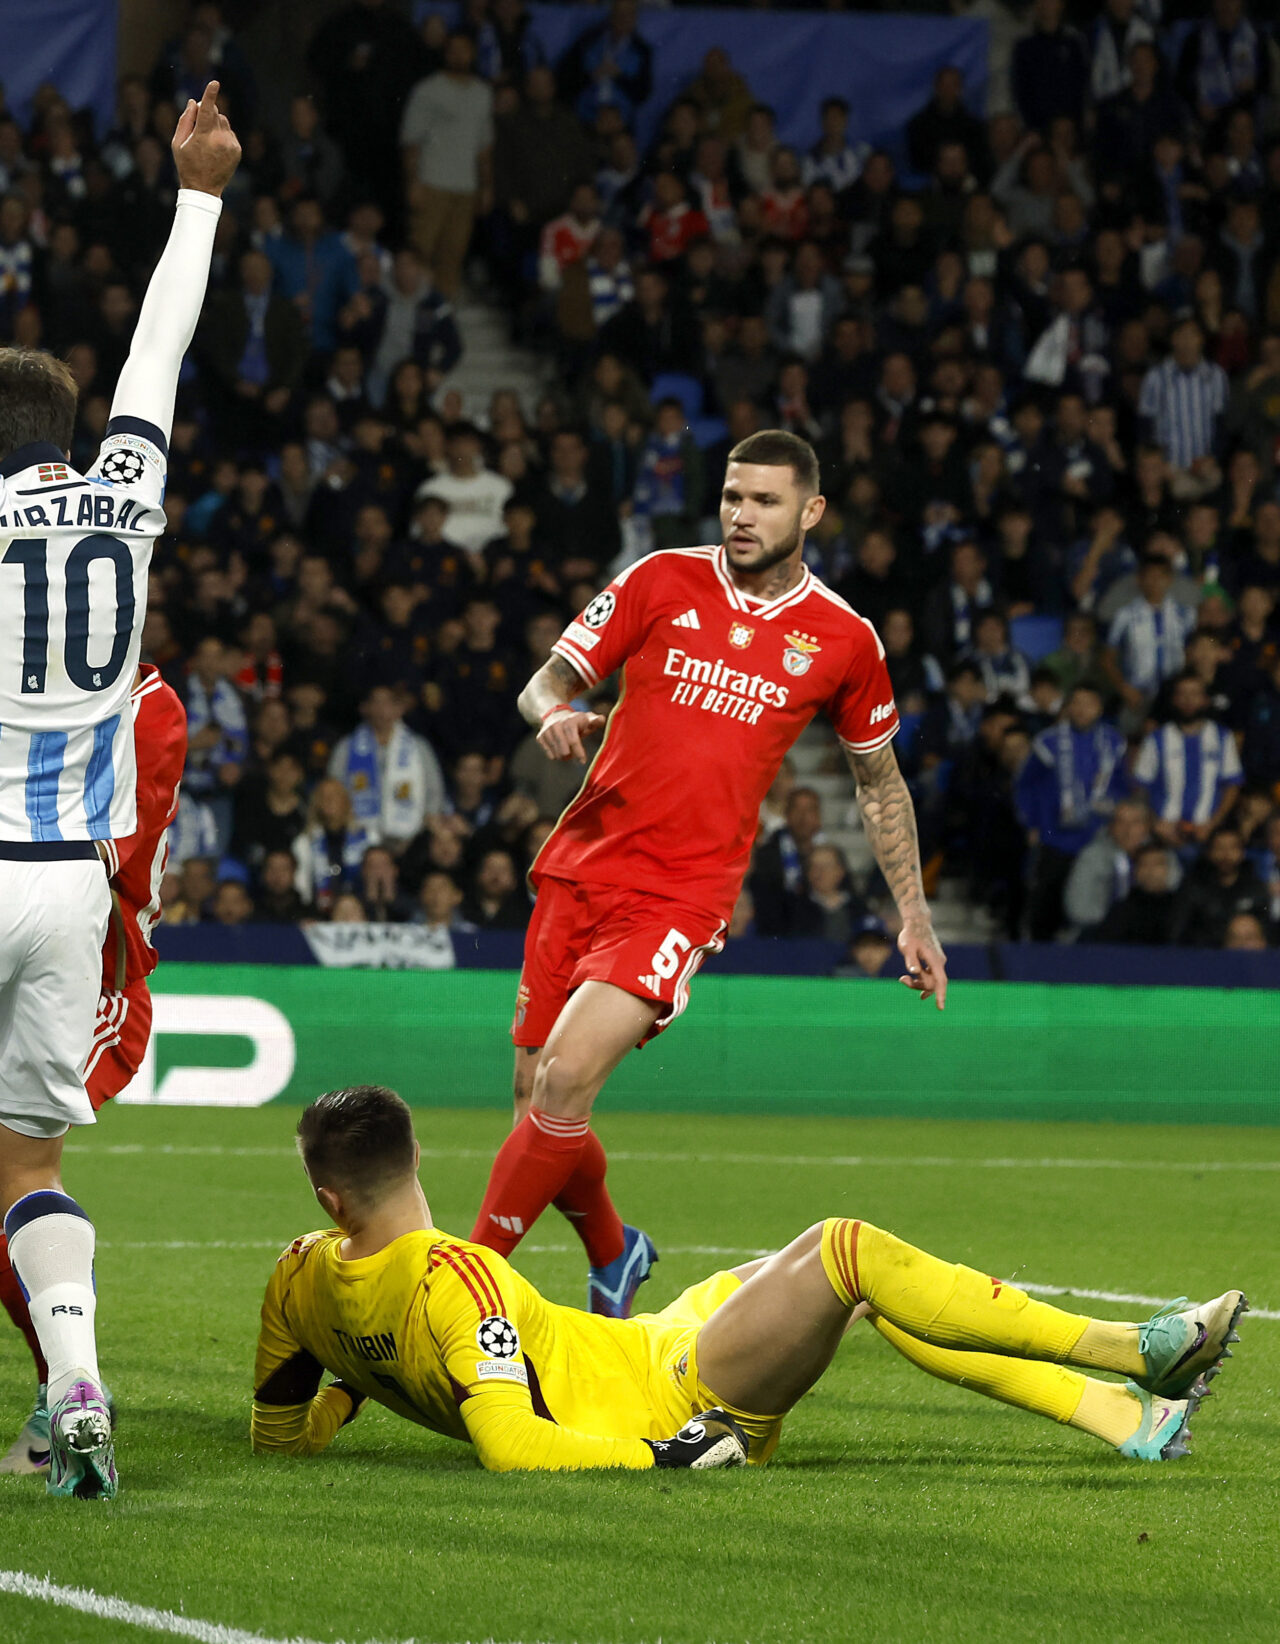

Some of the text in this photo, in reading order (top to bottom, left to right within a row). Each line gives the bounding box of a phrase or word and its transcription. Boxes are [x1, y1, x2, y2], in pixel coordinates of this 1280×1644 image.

[1, 534, 135, 693] 10
[664, 648, 789, 708] Emirates
[671, 682, 764, 725] FLY BETTER
[651, 928, 691, 979] 5
[52, 1305, 83, 1317] RS
